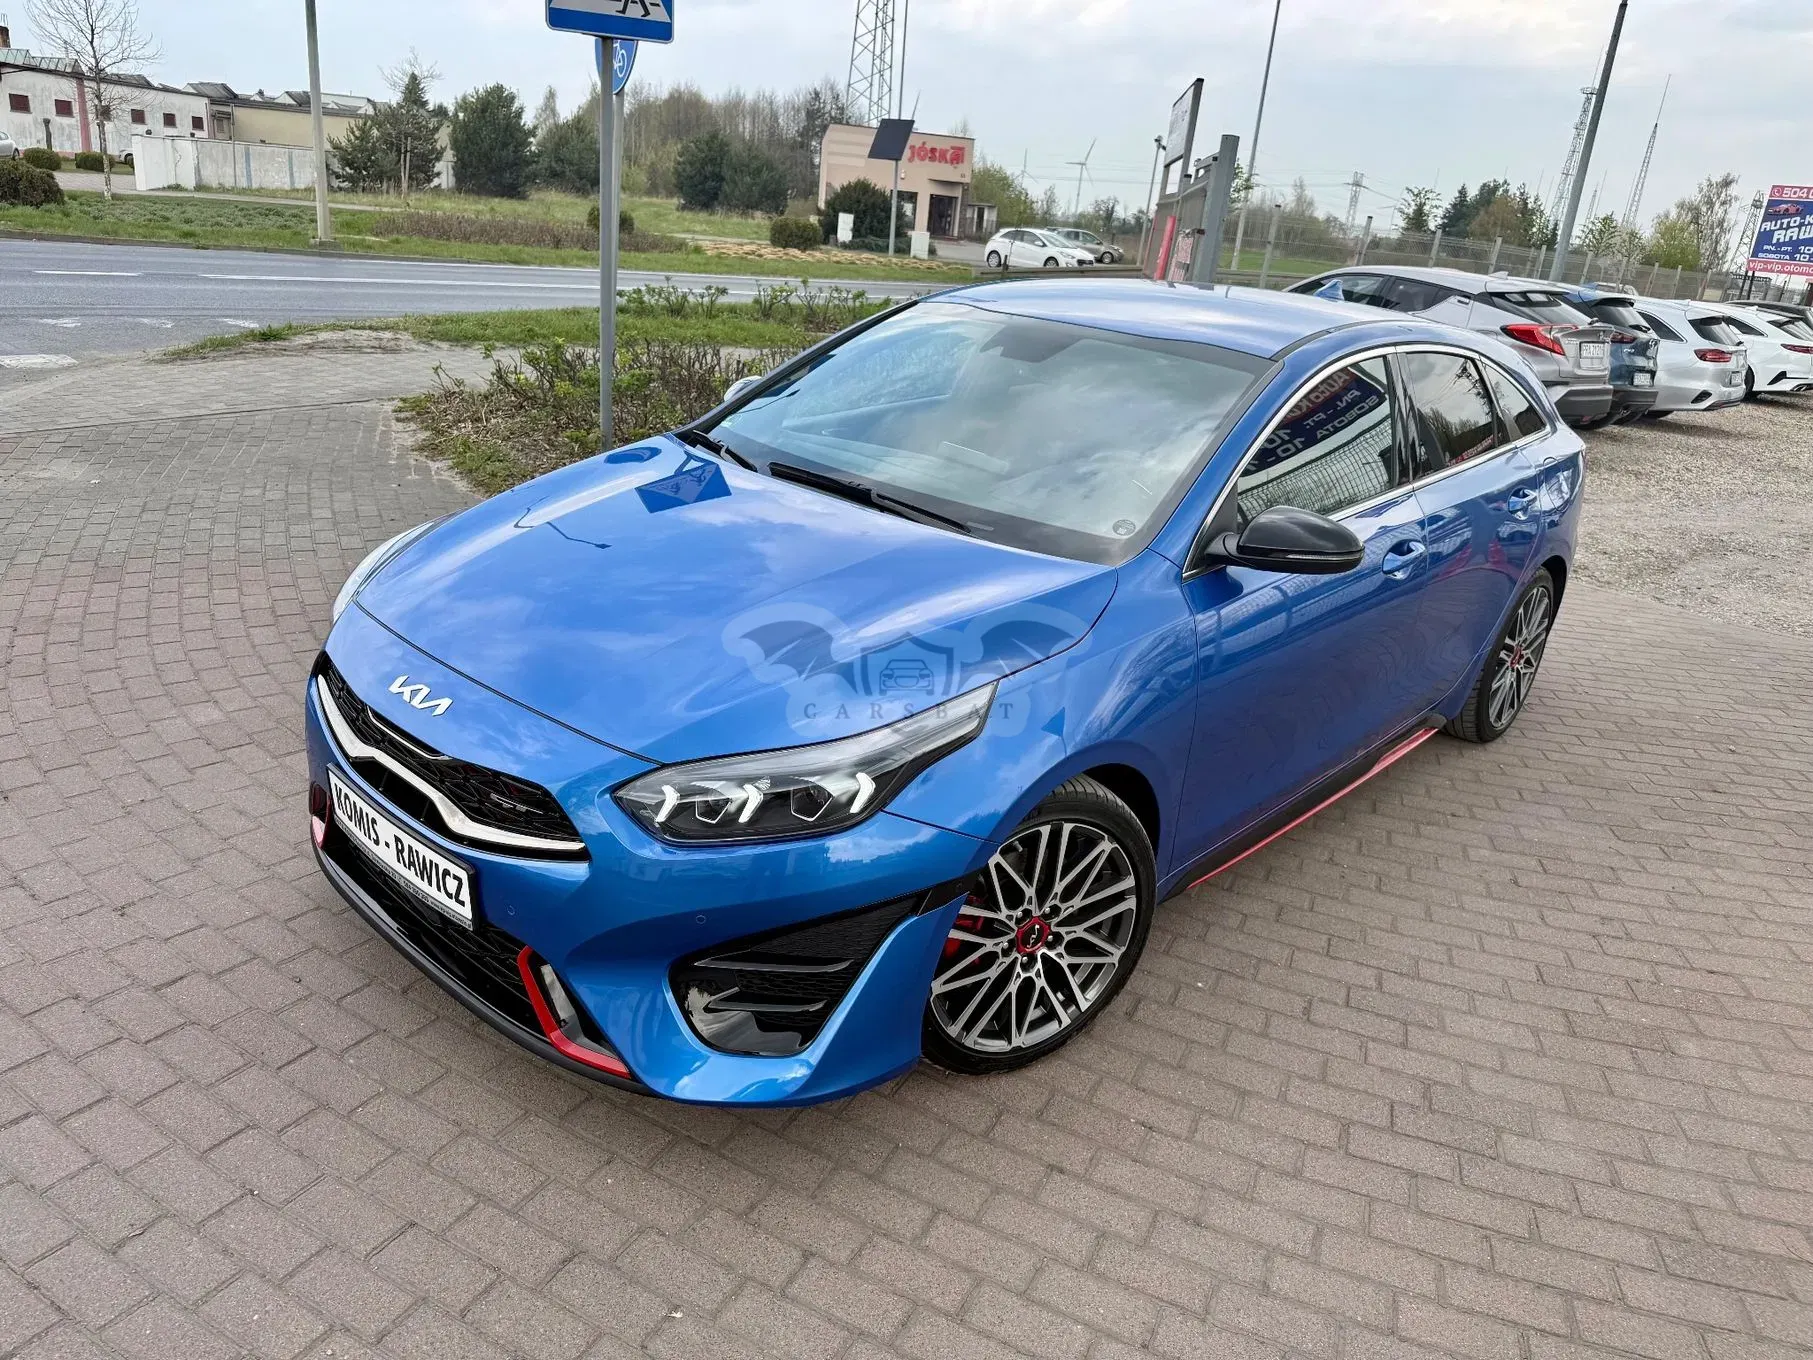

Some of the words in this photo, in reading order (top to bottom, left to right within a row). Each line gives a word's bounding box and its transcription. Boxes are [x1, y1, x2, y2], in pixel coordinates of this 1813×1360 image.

[1782, 187, 1807, 198] 504
[334, 782, 380, 847] KOMIS
[393, 833, 466, 908] RAWICZ
